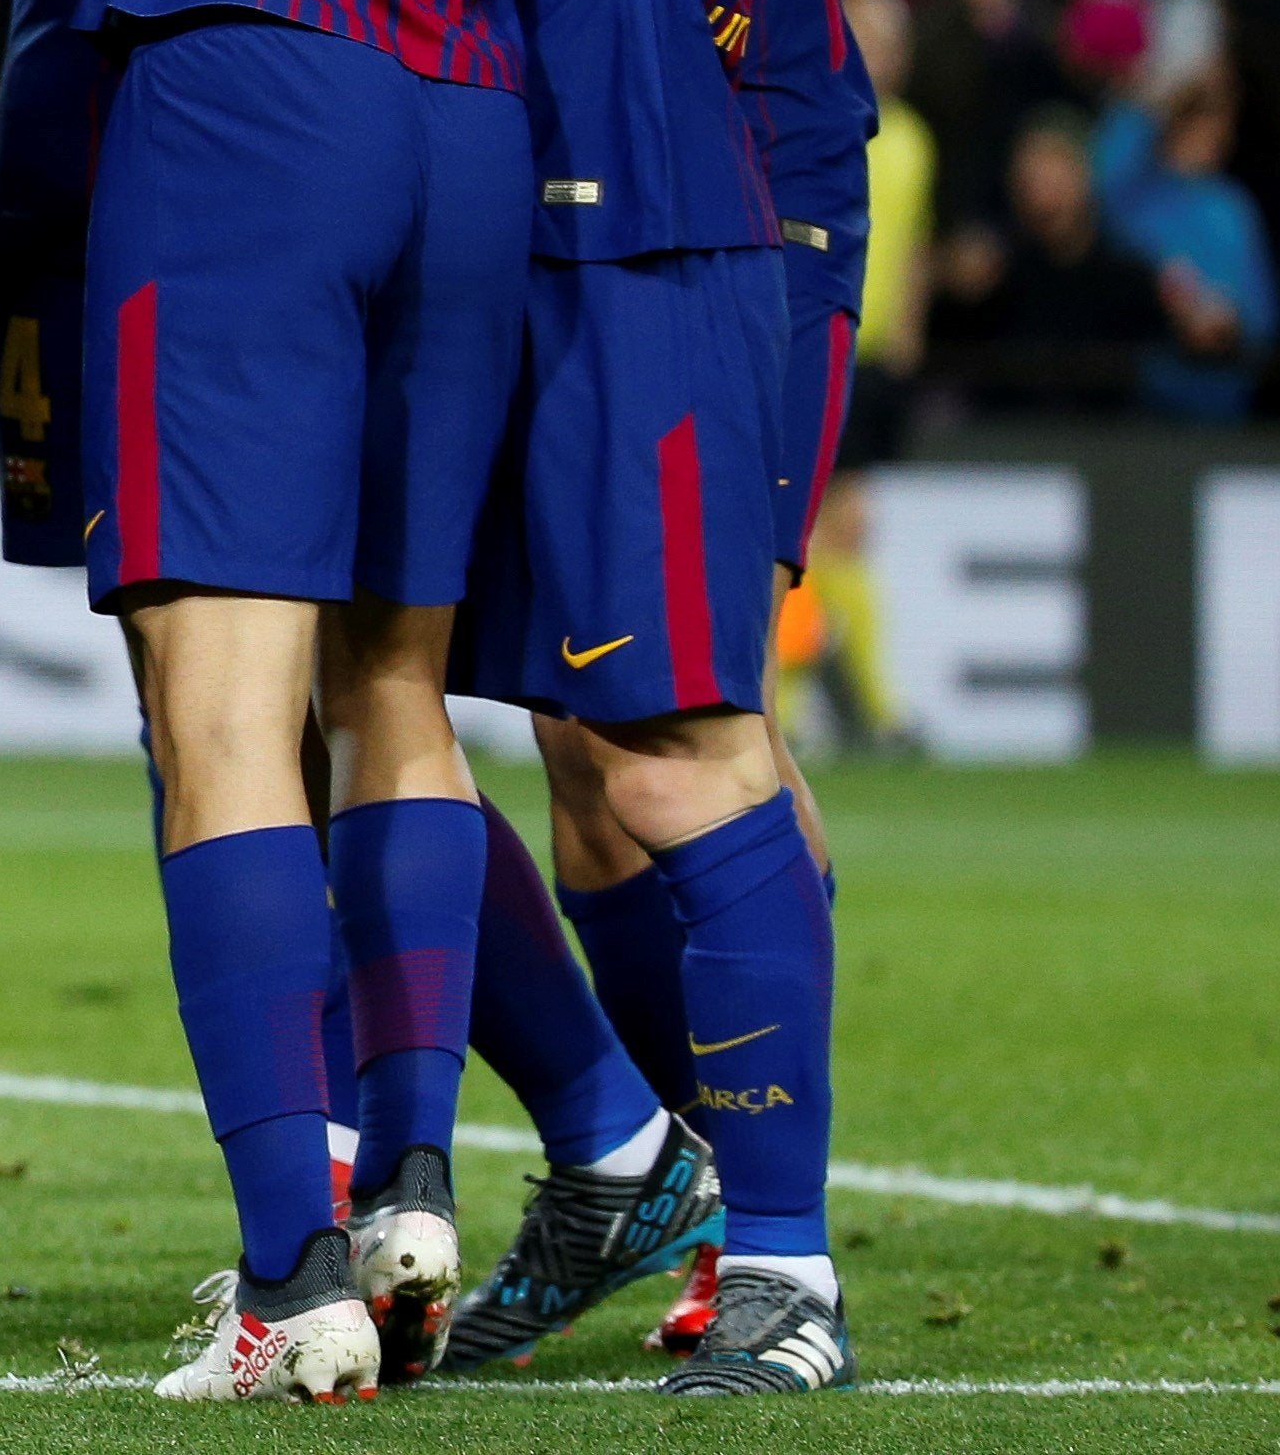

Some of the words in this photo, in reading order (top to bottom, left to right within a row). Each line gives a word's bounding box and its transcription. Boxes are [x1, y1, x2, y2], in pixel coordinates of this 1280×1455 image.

[696, 1080, 795, 1115] ARÇA
[623, 1147, 699, 1253] ESSI
[233, 1329, 288, 1397] adidas
